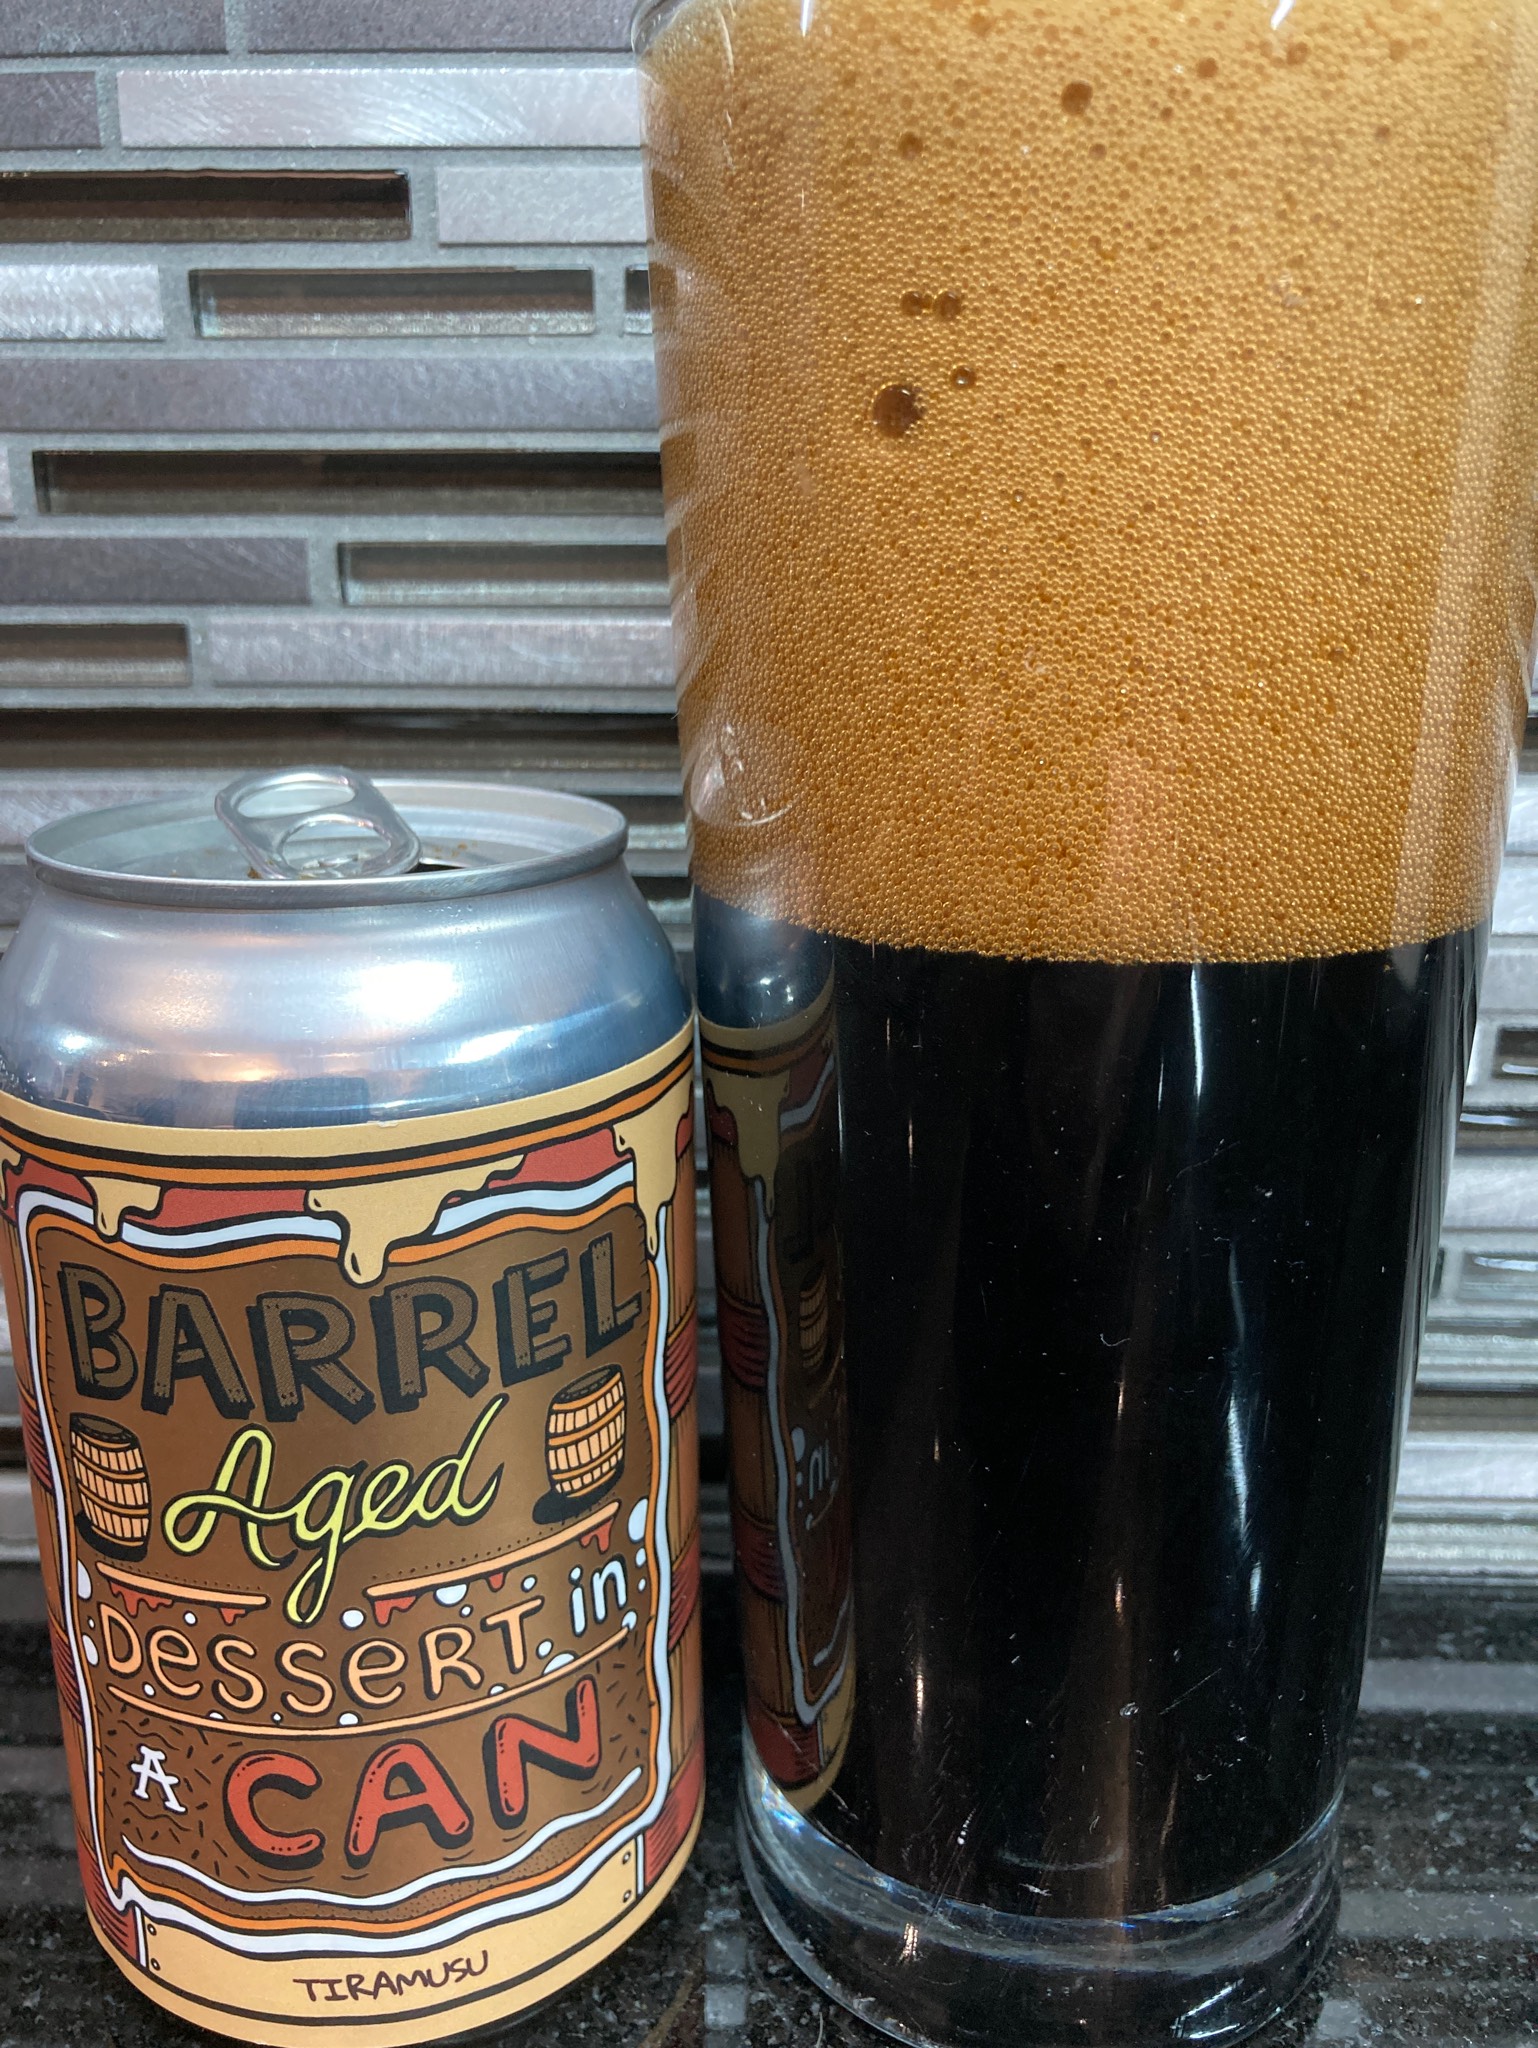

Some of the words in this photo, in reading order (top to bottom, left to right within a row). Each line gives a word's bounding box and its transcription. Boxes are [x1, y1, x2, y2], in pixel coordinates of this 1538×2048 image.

[58, 1234, 641, 1424] BARREL
[163, 1393, 506, 1624] Aged
[570, 1554, 628, 1636] in
[131, 1744, 187, 1813] A
[223, 1678, 602, 1870] CAN
[292, 1950, 488, 2002] TIRAMUSU
